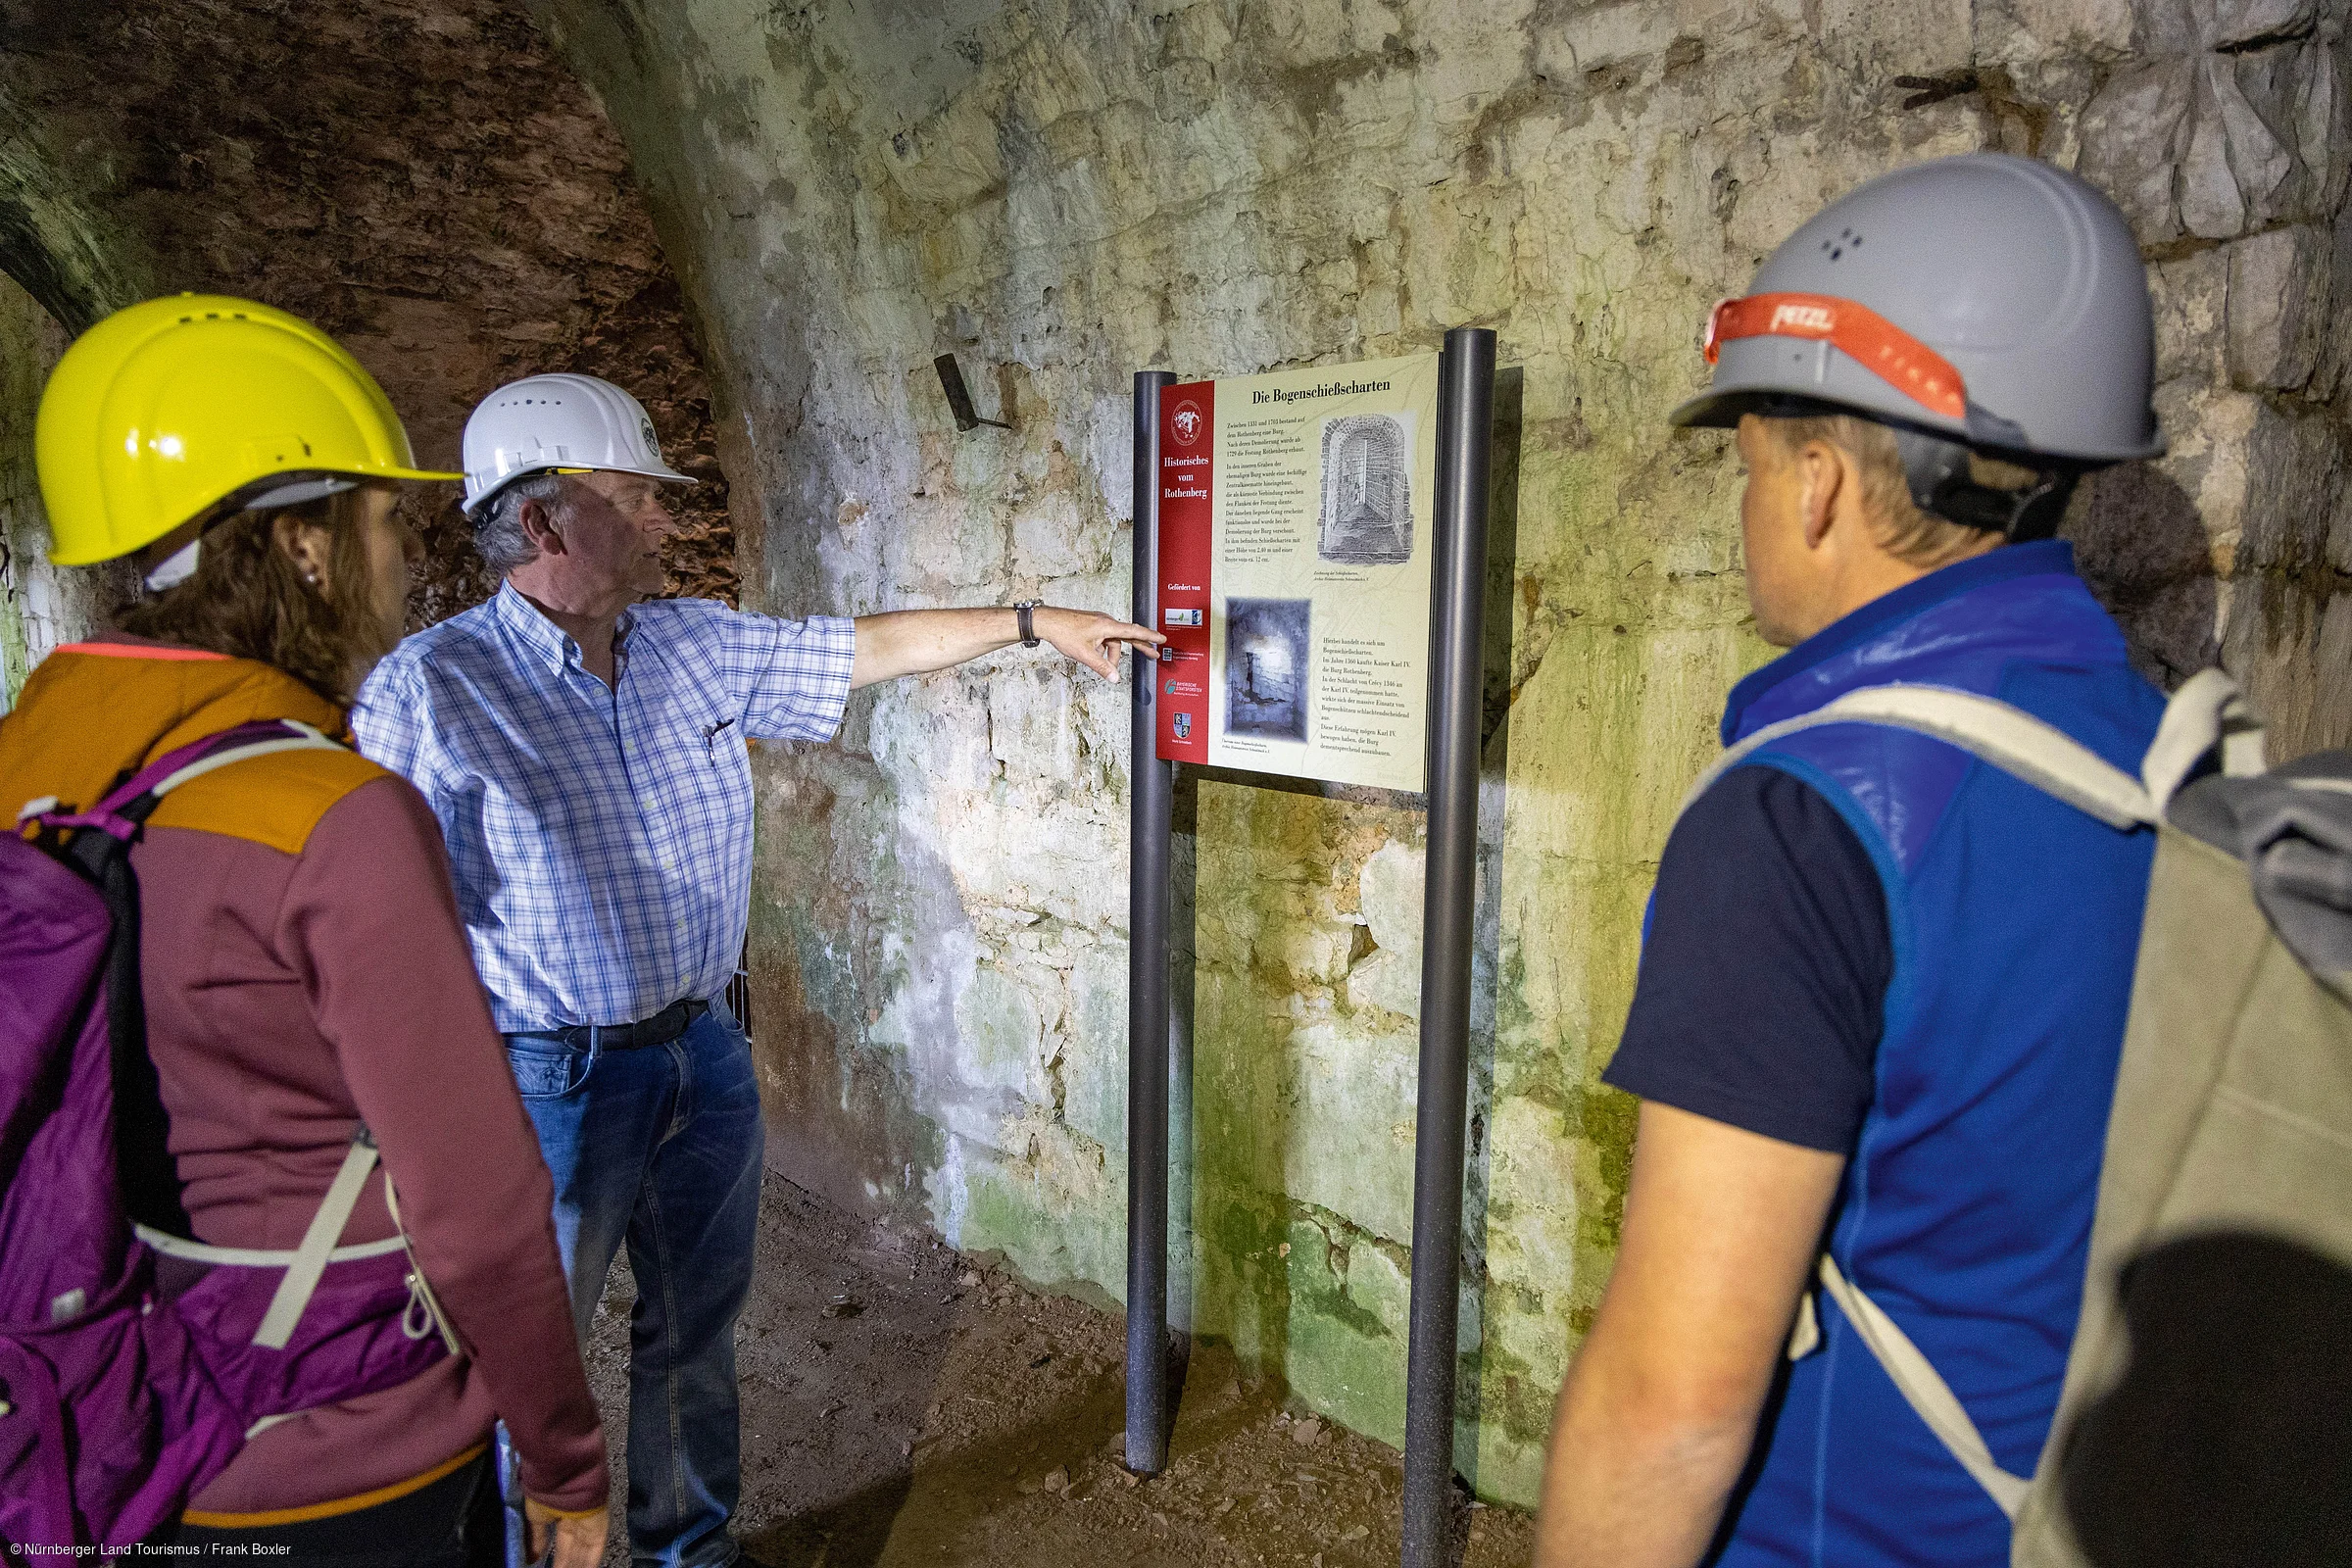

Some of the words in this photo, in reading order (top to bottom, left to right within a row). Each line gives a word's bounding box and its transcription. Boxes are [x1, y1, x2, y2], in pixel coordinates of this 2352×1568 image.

[1251, 390, 1271, 405] Die
[1273, 379, 1391, 406] Bogenschießscharten
[1163, 455, 1209, 467] Historisches
[1178, 472, 1194, 481] vom
[1164, 487, 1207, 500] Rothenberg
[1343, 667, 1373, 676] Rothenberg.
[1349, 688, 1384, 697] teilgenommen
[1321, 705, 1356, 713] Bogenschützen
[1334, 725, 1359, 734] Erfahrung
[1320, 733, 1341, 742] bewogen
[1366, 738, 1379, 747] Burg
[1320, 744, 1360, 753] dementsprechend
